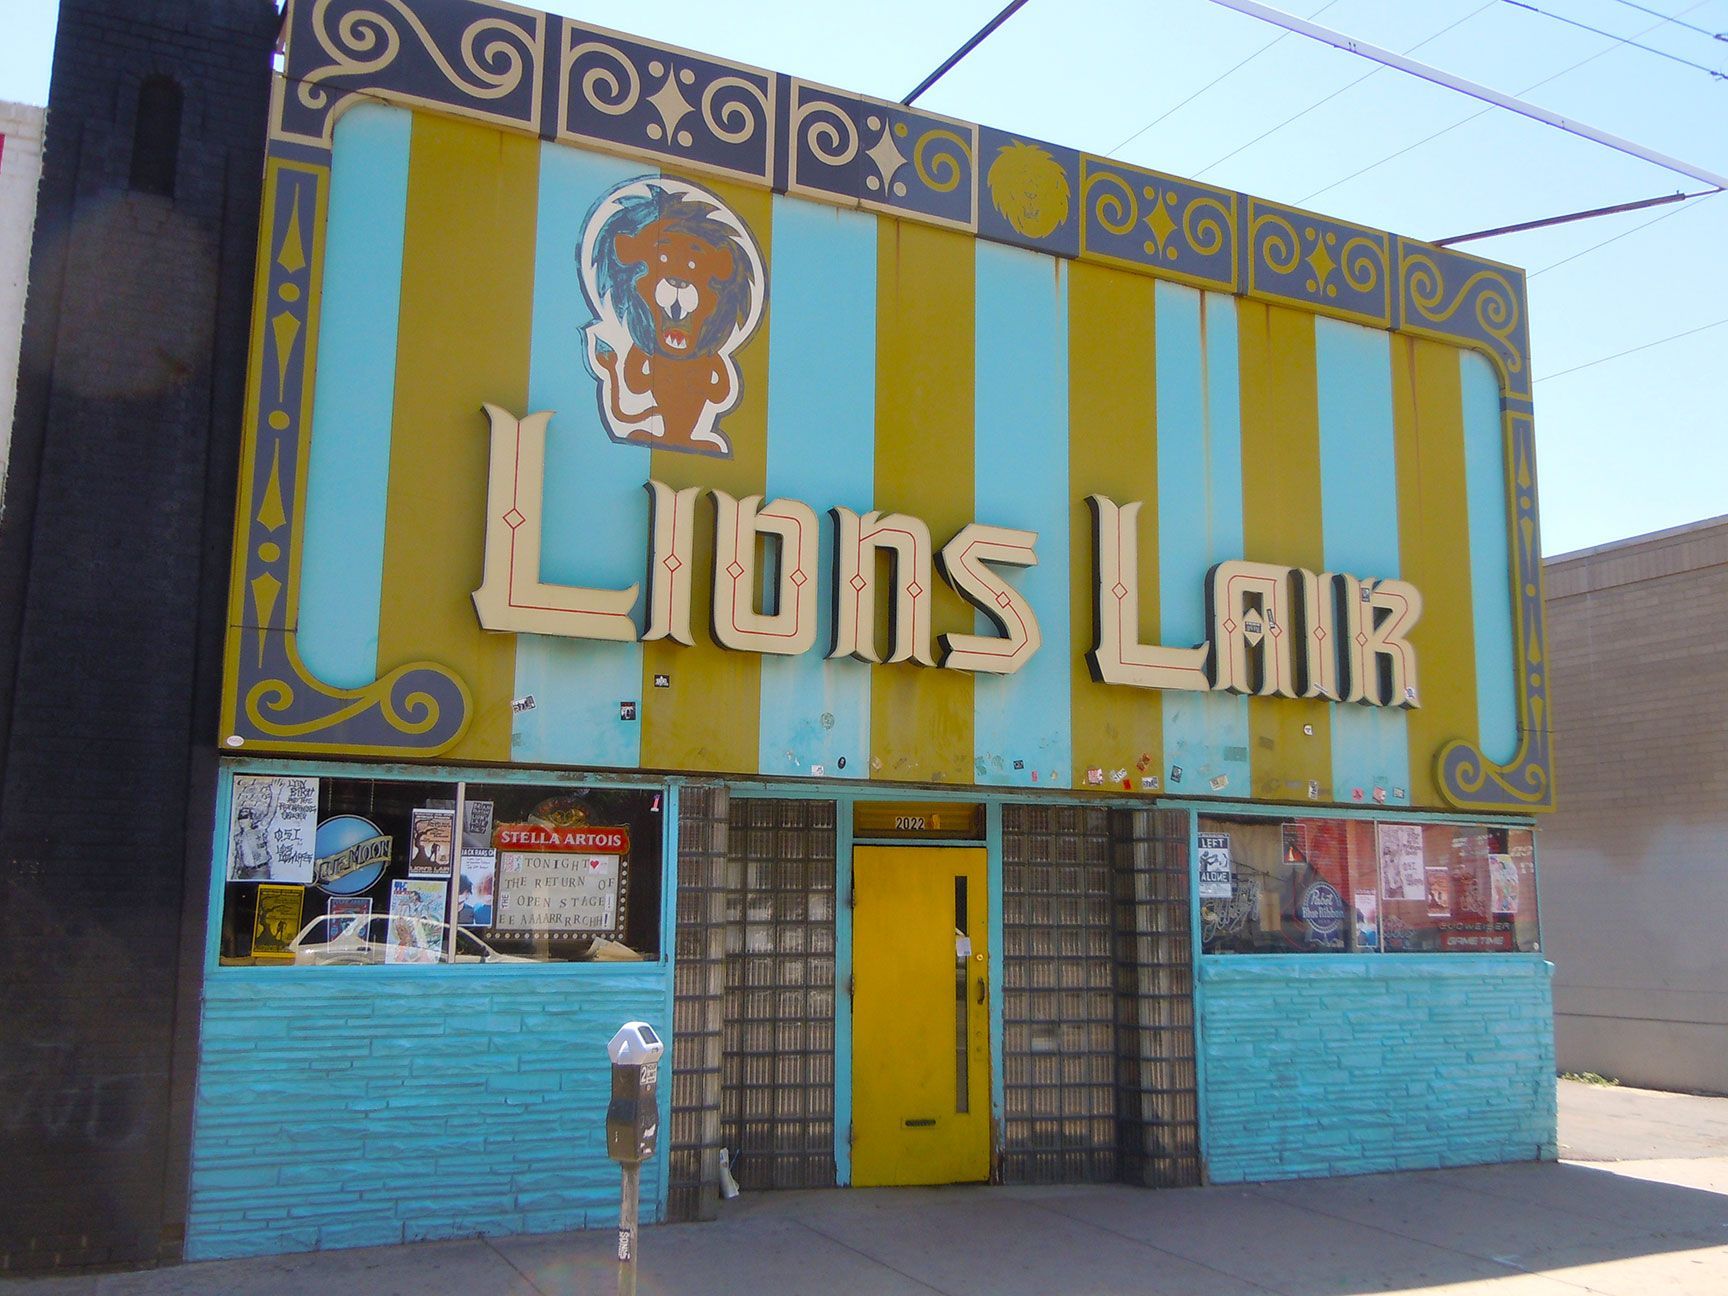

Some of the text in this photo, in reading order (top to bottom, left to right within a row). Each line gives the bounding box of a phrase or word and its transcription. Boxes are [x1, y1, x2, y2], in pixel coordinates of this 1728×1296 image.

[1084, 493, 1423, 709] LAIR
[895, 816, 925, 830] 2022
[501, 830, 622, 847] STELLA ARTOIS
[1201, 838, 1225, 848] LEFT
[349, 839, 390, 865] MOON
[524, 857, 590, 871] TONIGHT
[504, 876, 615, 891] THE RETURN OF
[1201, 872, 1228, 882] ALONE
[501, 894, 509, 909] THE
[517, 895, 551, 908] OPEN
[1447, 936, 1504, 946] GAME TIME
